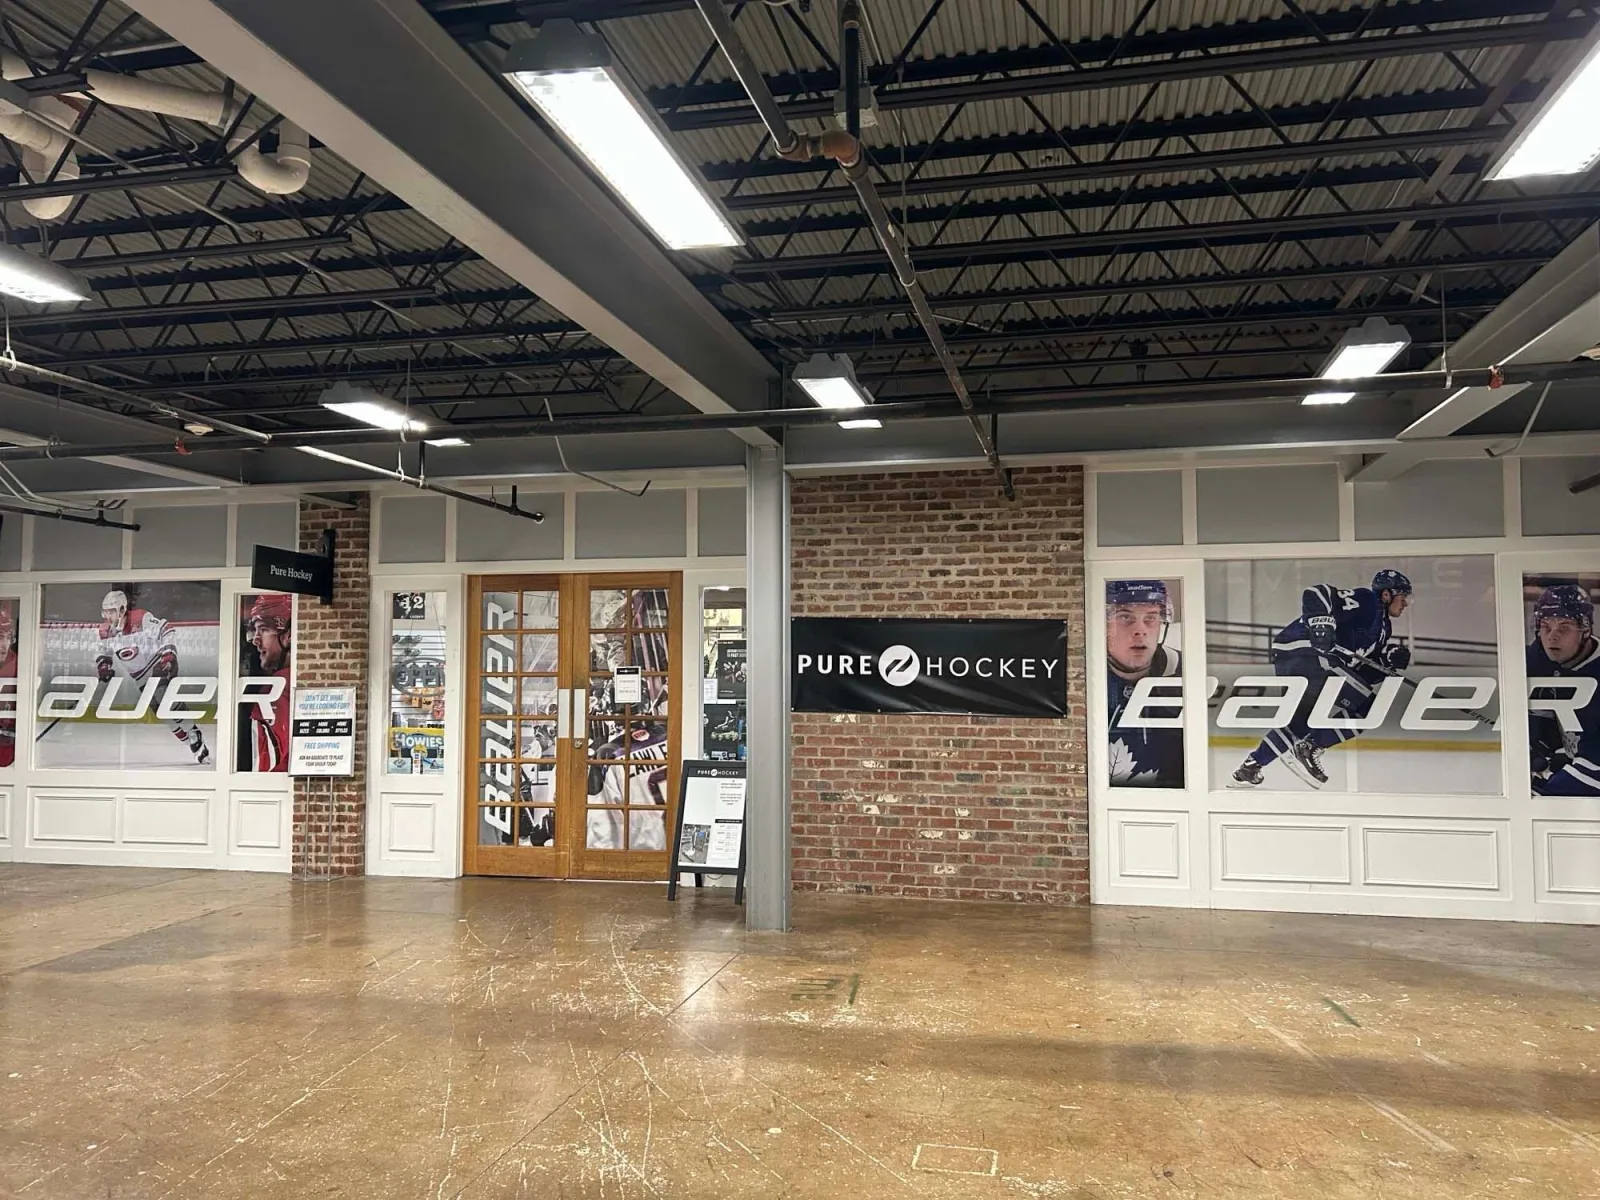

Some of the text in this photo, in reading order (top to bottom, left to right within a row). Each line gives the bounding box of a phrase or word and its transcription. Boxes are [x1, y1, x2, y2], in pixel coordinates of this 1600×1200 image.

[270, 565, 313, 582] Pure Hockey
[1337, 590, 1360, 610] 34
[797, 654, 1059, 679] PURE HOCKEY
[395, 733, 444, 748] HOWIES
